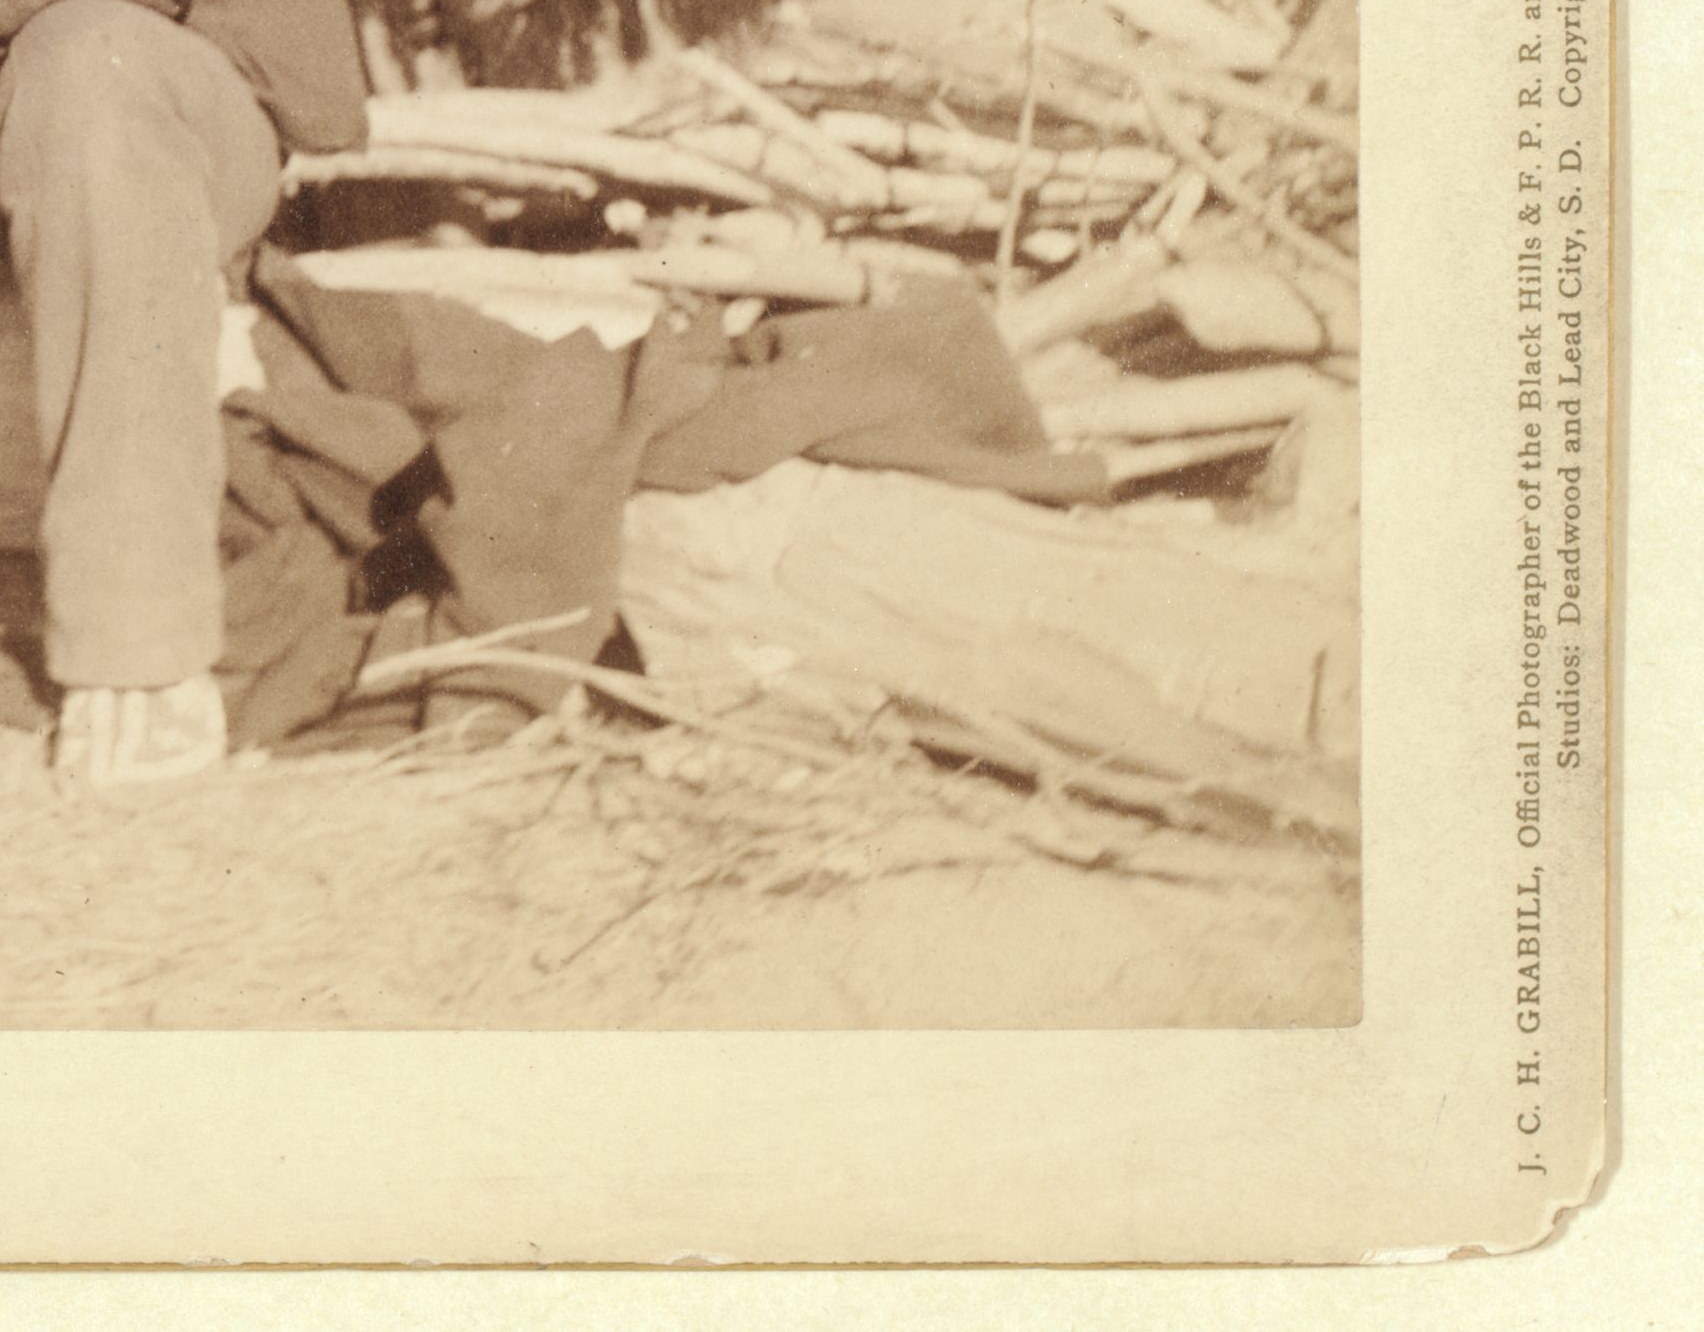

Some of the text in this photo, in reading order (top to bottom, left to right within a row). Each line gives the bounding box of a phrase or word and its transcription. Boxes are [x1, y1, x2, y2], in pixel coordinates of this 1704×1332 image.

[1518, 34, 1542, 64] R.
[1517, 78, 1542, 109] R.
[1518, 122, 1542, 151] P.
[1558, 140, 1582, 173] D.
[1518, 165, 1542, 193] F.
[1517, 203, 1541, 226] &
[1557, 187, 1582, 215] S.
[1517, 237, 1542, 312] Hills
[1557, 229, 1587, 299] City,
[1517, 324, 1542, 412] Black
[1557, 311, 1582, 386] Lead
[1517, 423, 1542, 471] the
[1557, 398, 1582, 454] and
[1517, 479, 1541, 511] of
[1557, 465, 1582, 626] Deadwood
[1516, 520, 1546, 730] Photographer
[1556, 646, 1581, 769] Studios:
[1515, 741, 1541, 848] Official
[1516, 866, 1544, 1034] GRABILL,
[1516, 1050, 1540, 1086] H.
[1517, 1105, 1541, 1135] C.
[1518, 1153, 1547, 1176] J.
